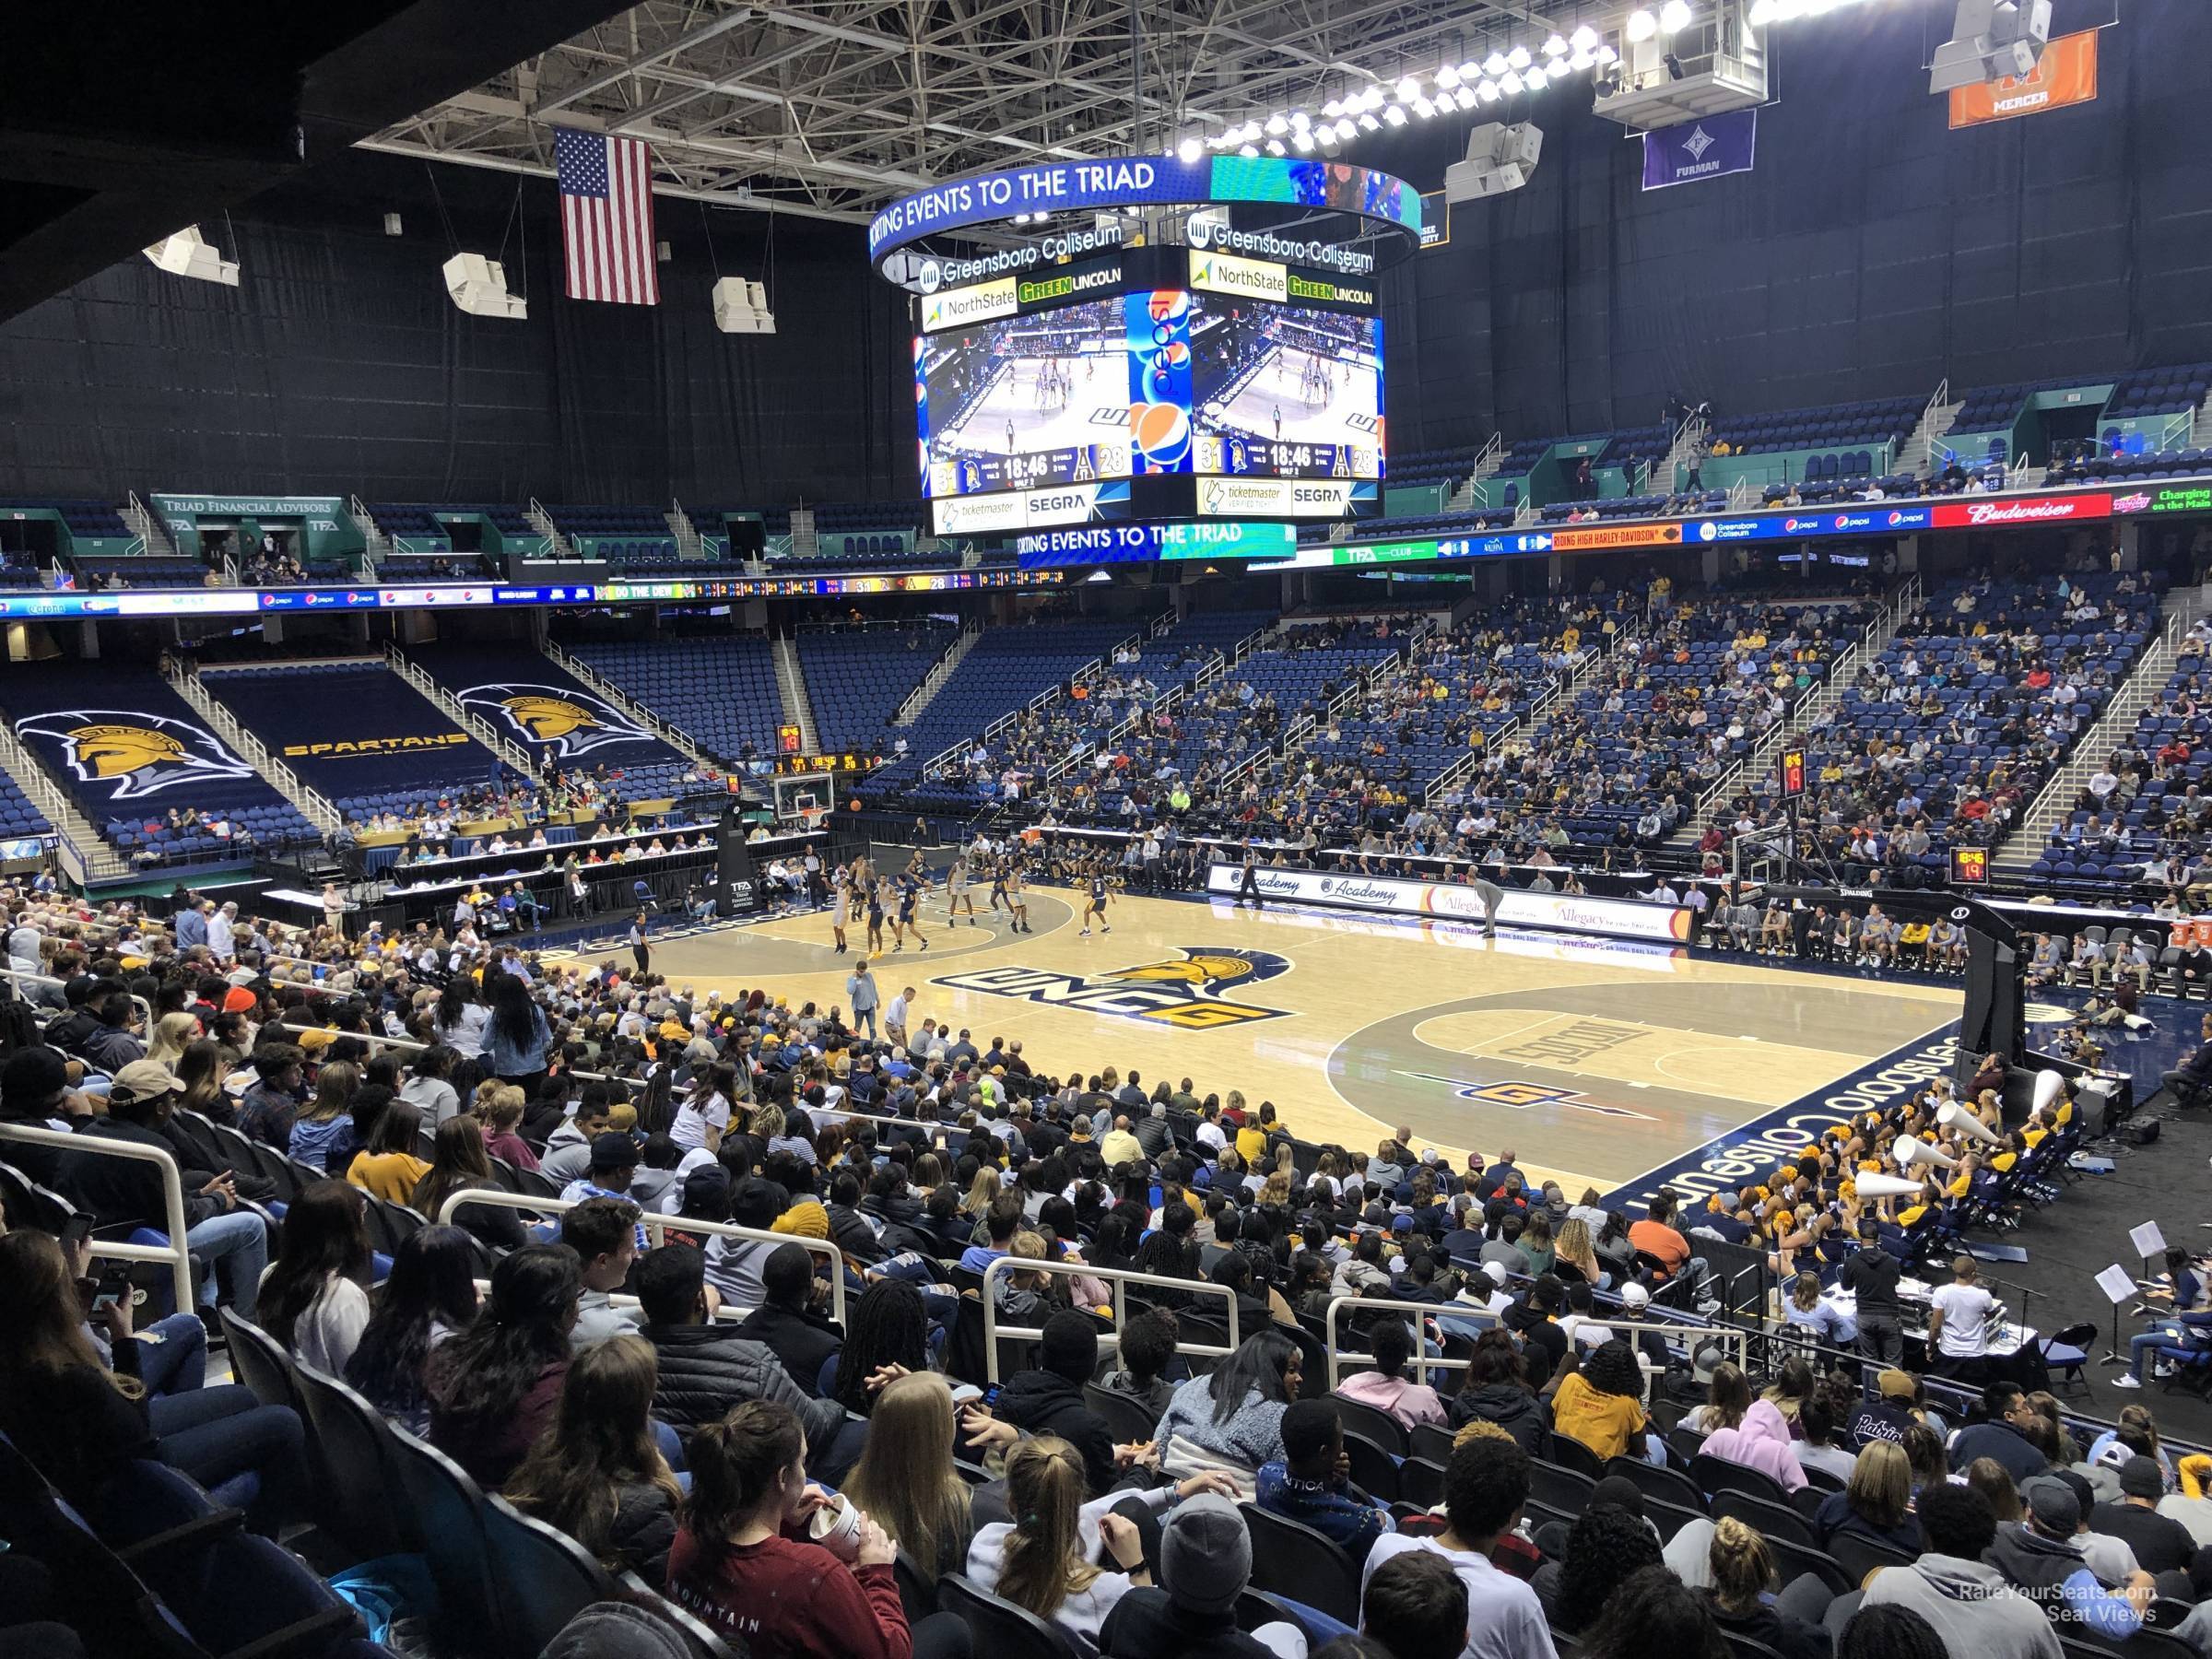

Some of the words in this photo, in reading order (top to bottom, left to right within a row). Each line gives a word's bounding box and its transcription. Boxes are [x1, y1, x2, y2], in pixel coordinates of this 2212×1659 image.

[1994, 91, 2049, 112] MERCER
[1676, 160, 1721, 178] FURMAN
[905, 185, 971, 226] EVENTS
[978, 177, 1012, 207] TO
[1018, 170, 1067, 200] THE
[1075, 162, 1156, 194] TRIAD
[943, 245, 1038, 284] Greensboro
[1041, 225, 1123, 262] Coliseum
[1213, 224, 1306, 260] Greensboro
[1309, 243, 1374, 272] Coliseum
[1018, 276, 1073, 303] GREEN
[1072, 267, 1123, 292] LINCOLN
[1218, 265, 1285, 291] NorthState
[1288, 275, 1335, 301] GREEN
[1334, 287, 1373, 306] LINCOLN
[947, 289, 1016, 317] NorthState
[1146, 300, 1179, 396] pepsi
[1099, 447, 1125, 474] 28
[1201, 442, 1223, 469] 31
[1270, 444, 1312, 466] 18:46
[1353, 450, 1372, 474] 28
[1004, 455, 1048, 479] 18:46
[936, 466, 958, 493] 31
[1229, 484, 1280, 499] ticketmaster
[1293, 488, 1343, 502] SEGRA
[2159, 489, 2211, 500] Charging
[164, 500, 205, 512] TRIAD
[207, 500, 274, 512] FINANCIAL
[275, 502, 332, 513] ADVISORS
[960, 502, 1014, 517] ticketmaster
[1029, 495, 1086, 513] SEGRA
[1968, 501, 2075, 524] Budweiser
[2167, 500, 2183, 510] the
[2185, 500, 2211, 508] Main
[309, 520, 340, 532] TFA
[1717, 522, 1758, 532] Greensboro
[1798, 520, 1818, 531] pepsi
[1849, 517, 1870, 528] pepsi
[1902, 513, 1924, 524] pepsi
[1052, 529, 1112, 552] EVENTS
[1116, 526, 1145, 547] TO
[1149, 524, 1186, 545] THE
[1194, 523, 1242, 543] TRIAD
[1554, 535, 1576, 547] RIDING
[1577, 534, 1594, 546] HIGH
[1717, 529, 1749, 538] Coliseum
[1347, 547, 1377, 563] TFA
[1390, 547, 1412, 558] CLUB
[616, 586, 628, 598] DO
[631, 585, 650, 598] THE
[743, 584, 753, 593] 14
[768, 583, 778, 592] 21
[855, 581, 871, 593] 31
[930, 578, 946, 590] 28
[29, 604, 66, 616] Corona
[284, 734, 469, 758] SPARTANS
[1959, 852, 1984, 865] 18:46
[1965, 865, 1981, 878] 19
[731, 881, 753, 892] TFA
[1253, 872, 1302, 896] cademy
[1334, 879, 1398, 906] Academy
[1840, 888, 1874, 899] SPALDING
[1444, 895, 1484, 916] Allegac
[1557, 906, 1606, 930] Allegacy
[927, 966, 1300, 1031] UNCG
[670, 1580, 760, 1634] MOUNTAIN
